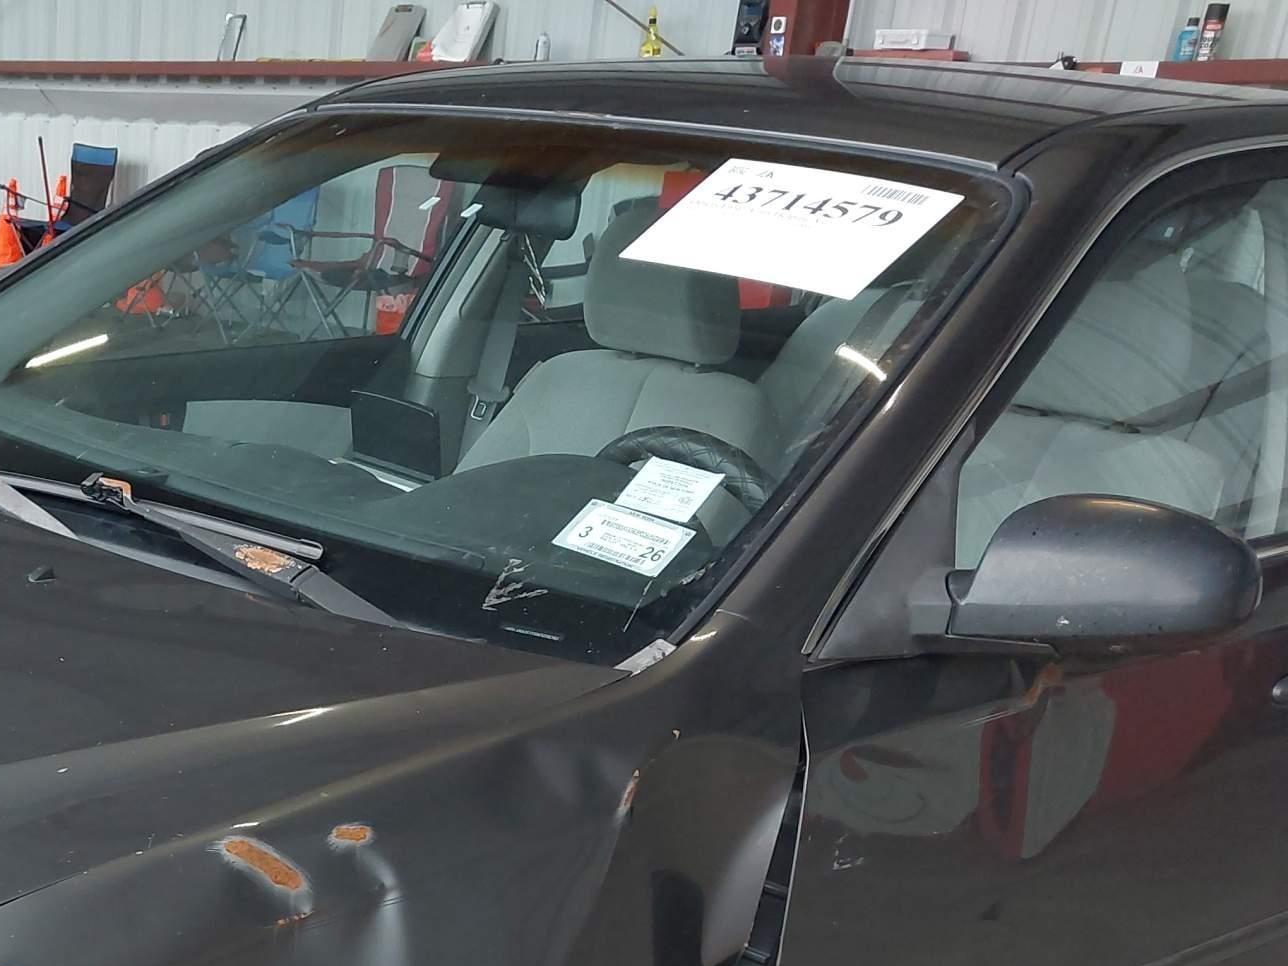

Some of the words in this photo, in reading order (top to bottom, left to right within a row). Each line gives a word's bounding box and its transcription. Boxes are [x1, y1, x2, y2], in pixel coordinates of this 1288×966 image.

[714, 183, 903, 227] 43714579
[578, 526, 593, 538] 3
[639, 546, 665, 562] 26
